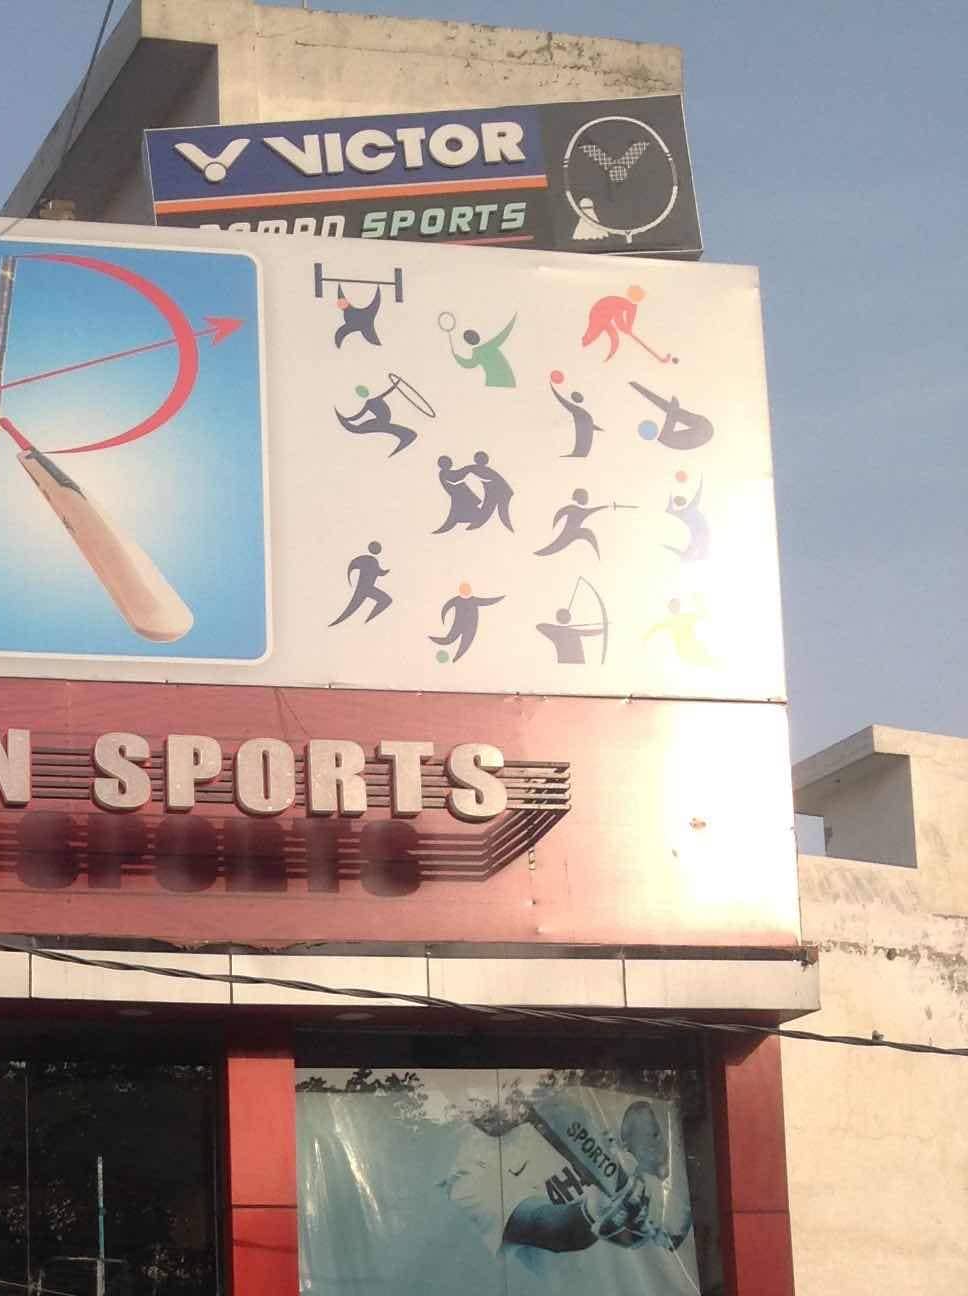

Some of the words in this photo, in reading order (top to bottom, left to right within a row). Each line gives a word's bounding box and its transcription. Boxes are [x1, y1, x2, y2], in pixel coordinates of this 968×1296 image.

[263, 120, 528, 177] VICTOR
[361, 201, 528, 239] SPORTS
[90, 731, 507, 820] SPORTS
